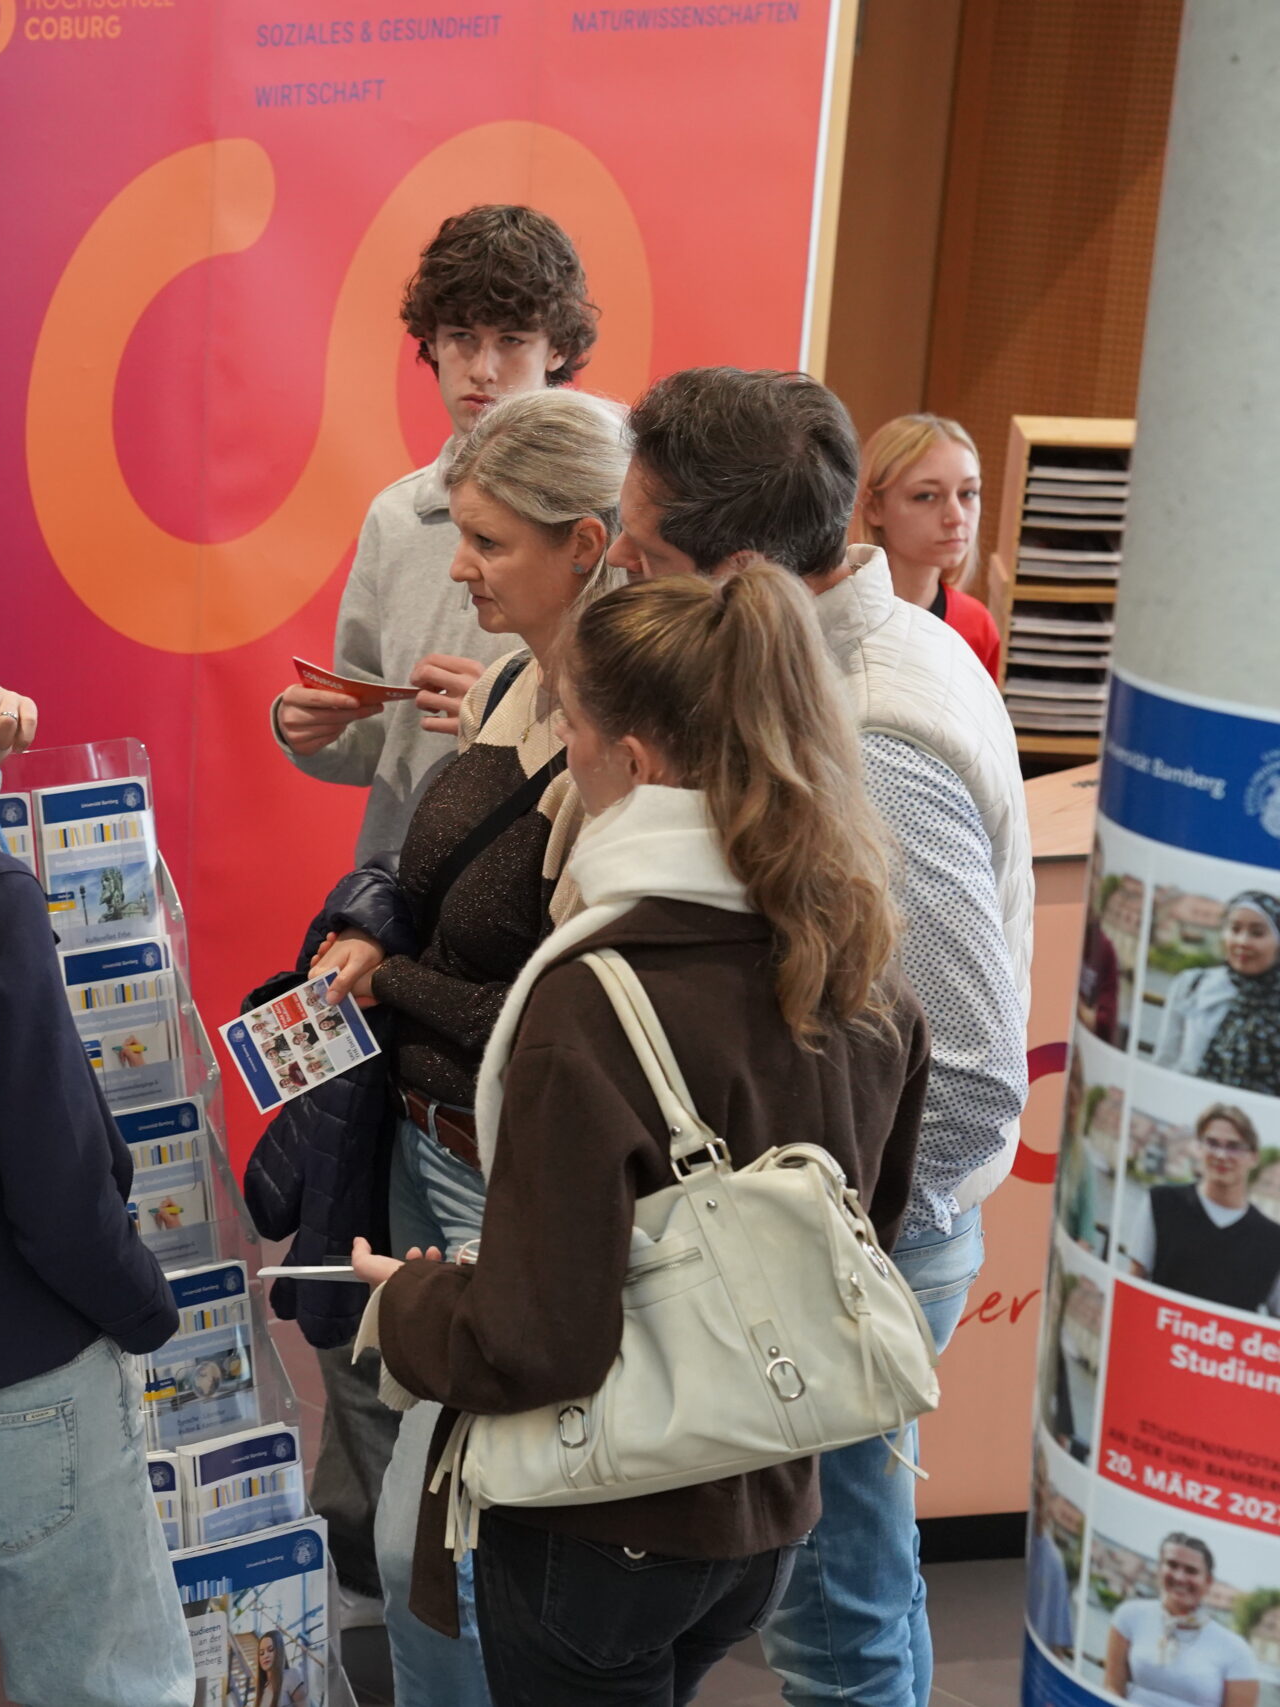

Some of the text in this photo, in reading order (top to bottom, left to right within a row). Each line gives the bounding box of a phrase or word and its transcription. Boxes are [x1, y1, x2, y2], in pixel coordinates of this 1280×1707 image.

[23, 14, 122, 41] COBURG
[255, 14, 503, 49] SOZIALES & GESUNDHEIT
[571, 2, 800, 33] NATURWISSENSCHAFTEN
[255, 78, 385, 108] WIRTSCHAFT
[1151, 757, 1226, 800] Bamberg
[1156, 1306, 1280, 1364] Finde de
[1105, 1449, 1280, 1527] 20. MÄRZ 202
